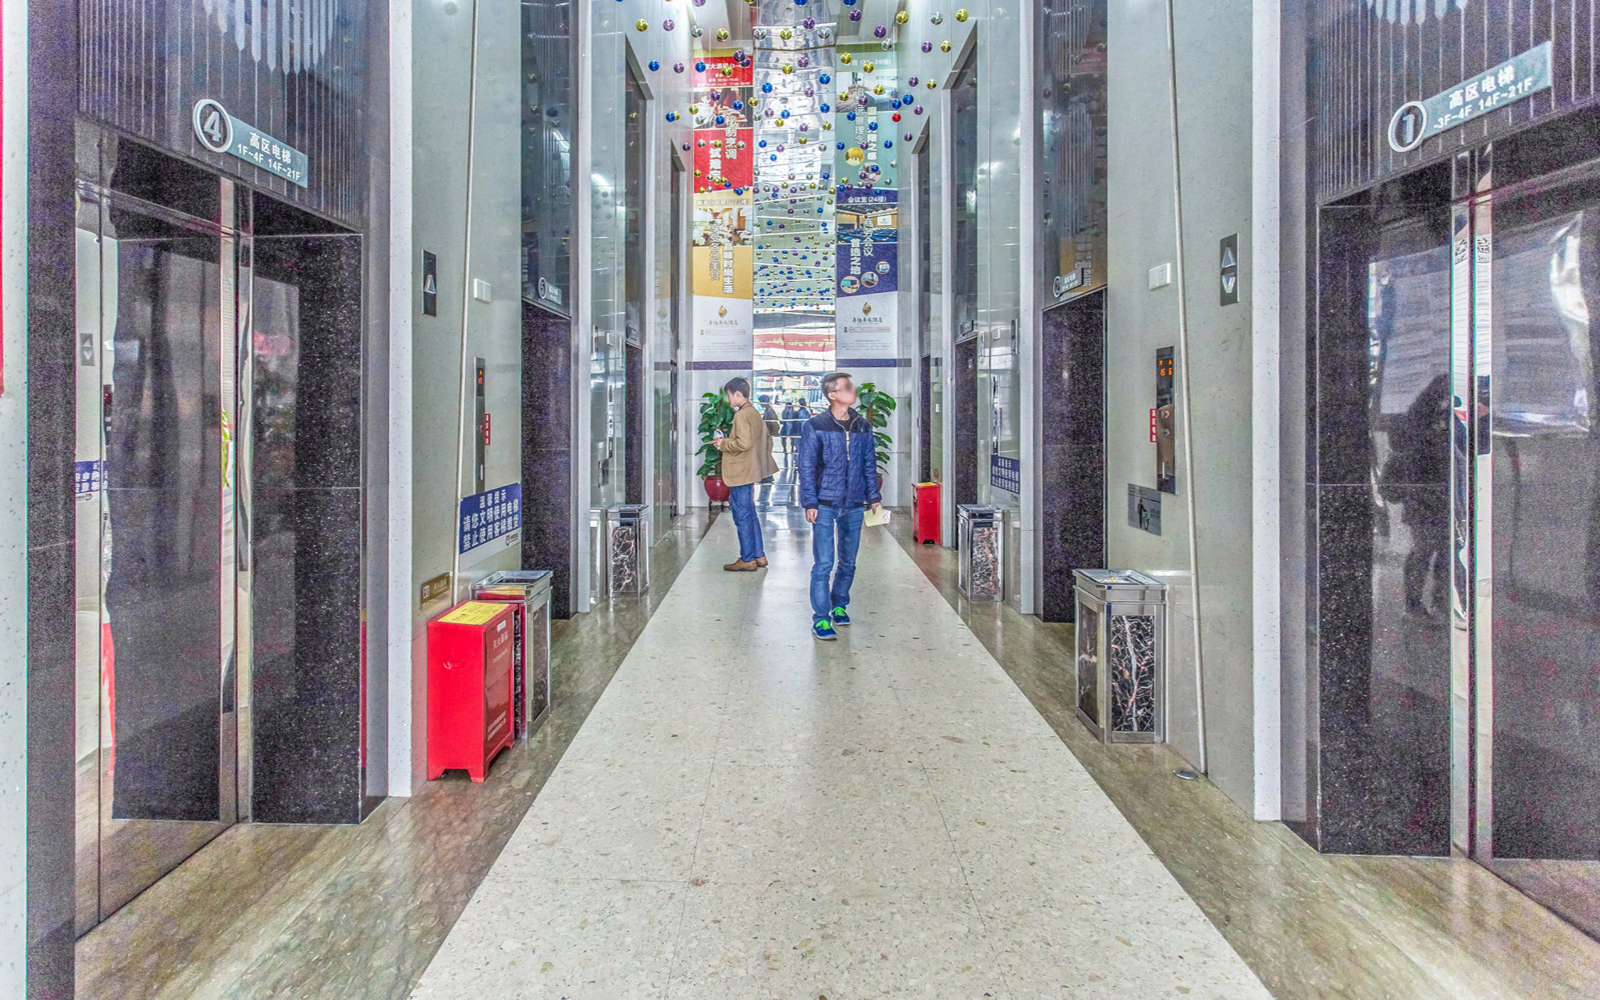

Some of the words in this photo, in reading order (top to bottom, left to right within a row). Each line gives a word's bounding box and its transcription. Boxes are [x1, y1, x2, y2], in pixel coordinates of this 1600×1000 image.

[1449, 65, 1514, 110] 高区电梯
[203, 111, 221, 142] 4
[725, 116, 737, 159] 秘制烹调
[1403, 114, 1415, 143] 1
[249, 132, 292, 164] 高区电梯
[723, 242, 734, 294] 品味时尚生活
[850, 238, 861, 275] 首选之地
[463, 498, 519, 533] 请您文明使用电梯
[479, 489, 507, 509] 温馨提示
[463, 514, 519, 551] 禁止使用客梯载货
